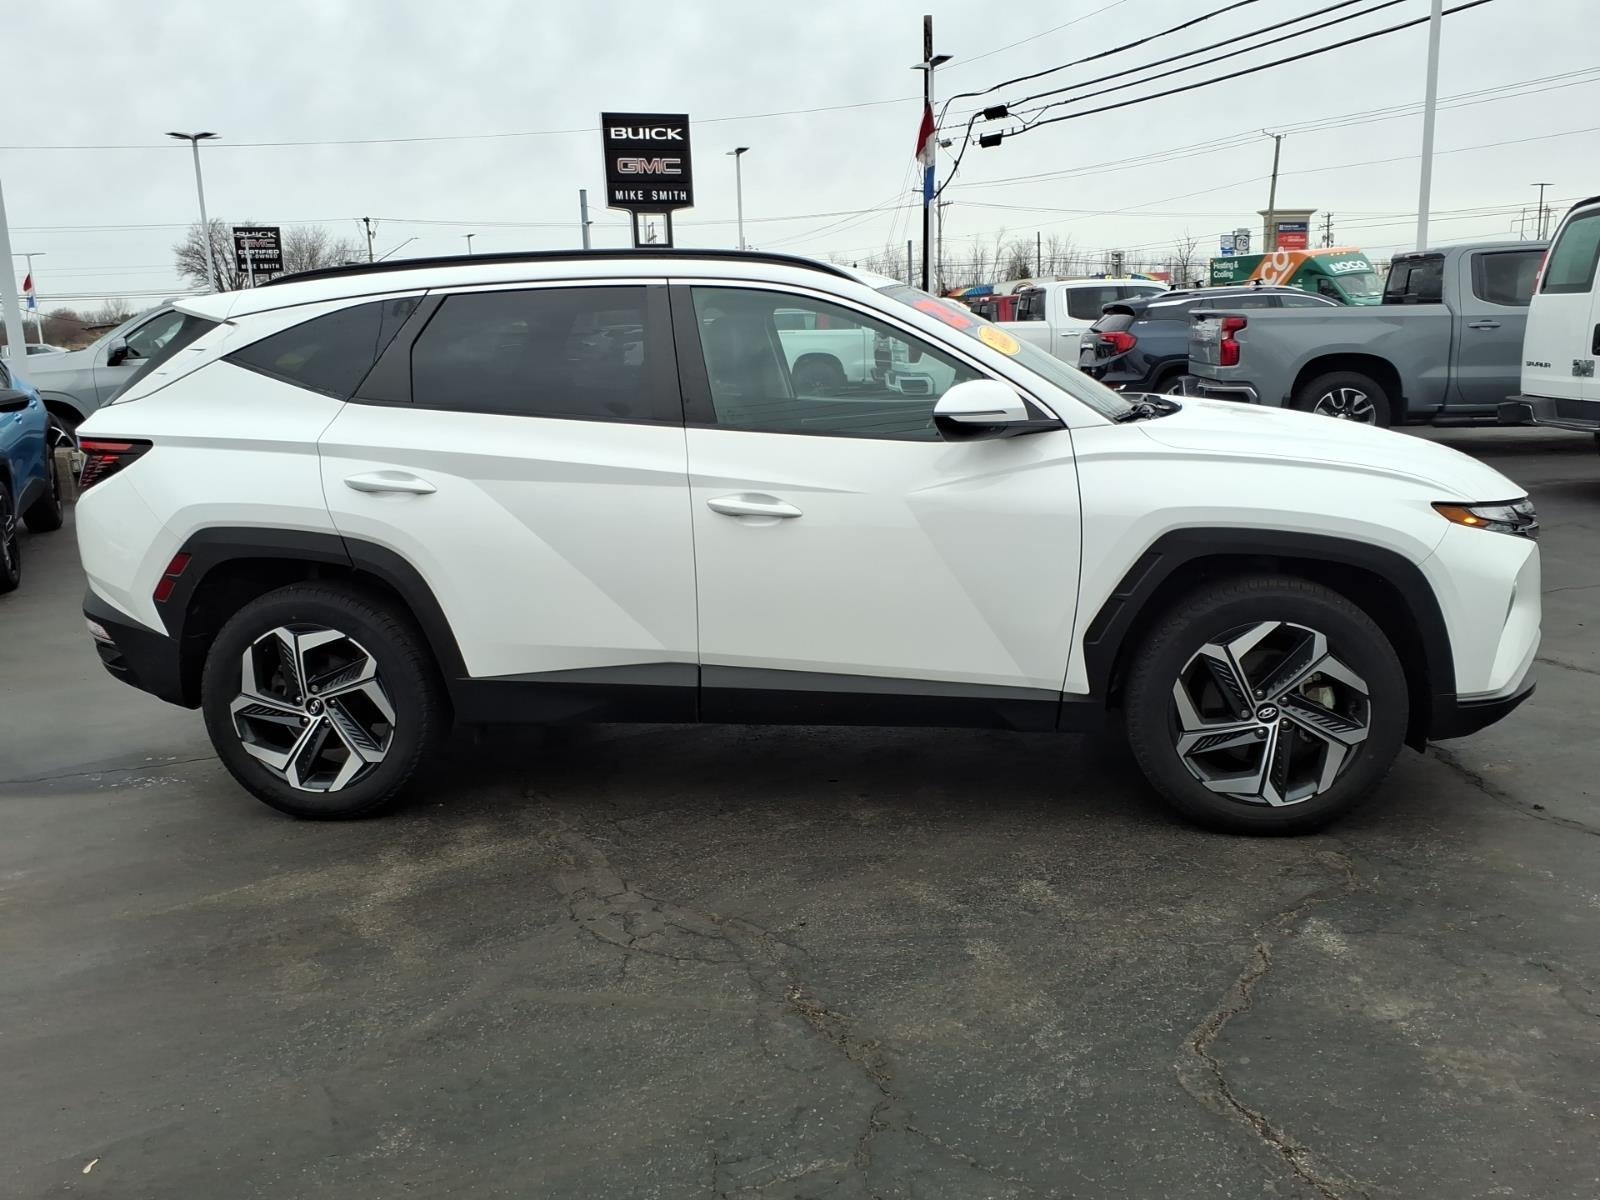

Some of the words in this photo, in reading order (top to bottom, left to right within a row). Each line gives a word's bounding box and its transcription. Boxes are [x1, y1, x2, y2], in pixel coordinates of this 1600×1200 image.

[610, 127, 684, 140] BUICK
[617, 158, 682, 174] GMC
[615, 190, 644, 200] MIKE
[652, 191, 687, 201] SMITH
[1238, 238, 1248, 247] 78
[1213, 261, 1233, 270] Heating
[1234, 260, 1239, 268] &
[1329, 260, 1368, 271] NOCO
[1213, 271, 1233, 279] Cooling
